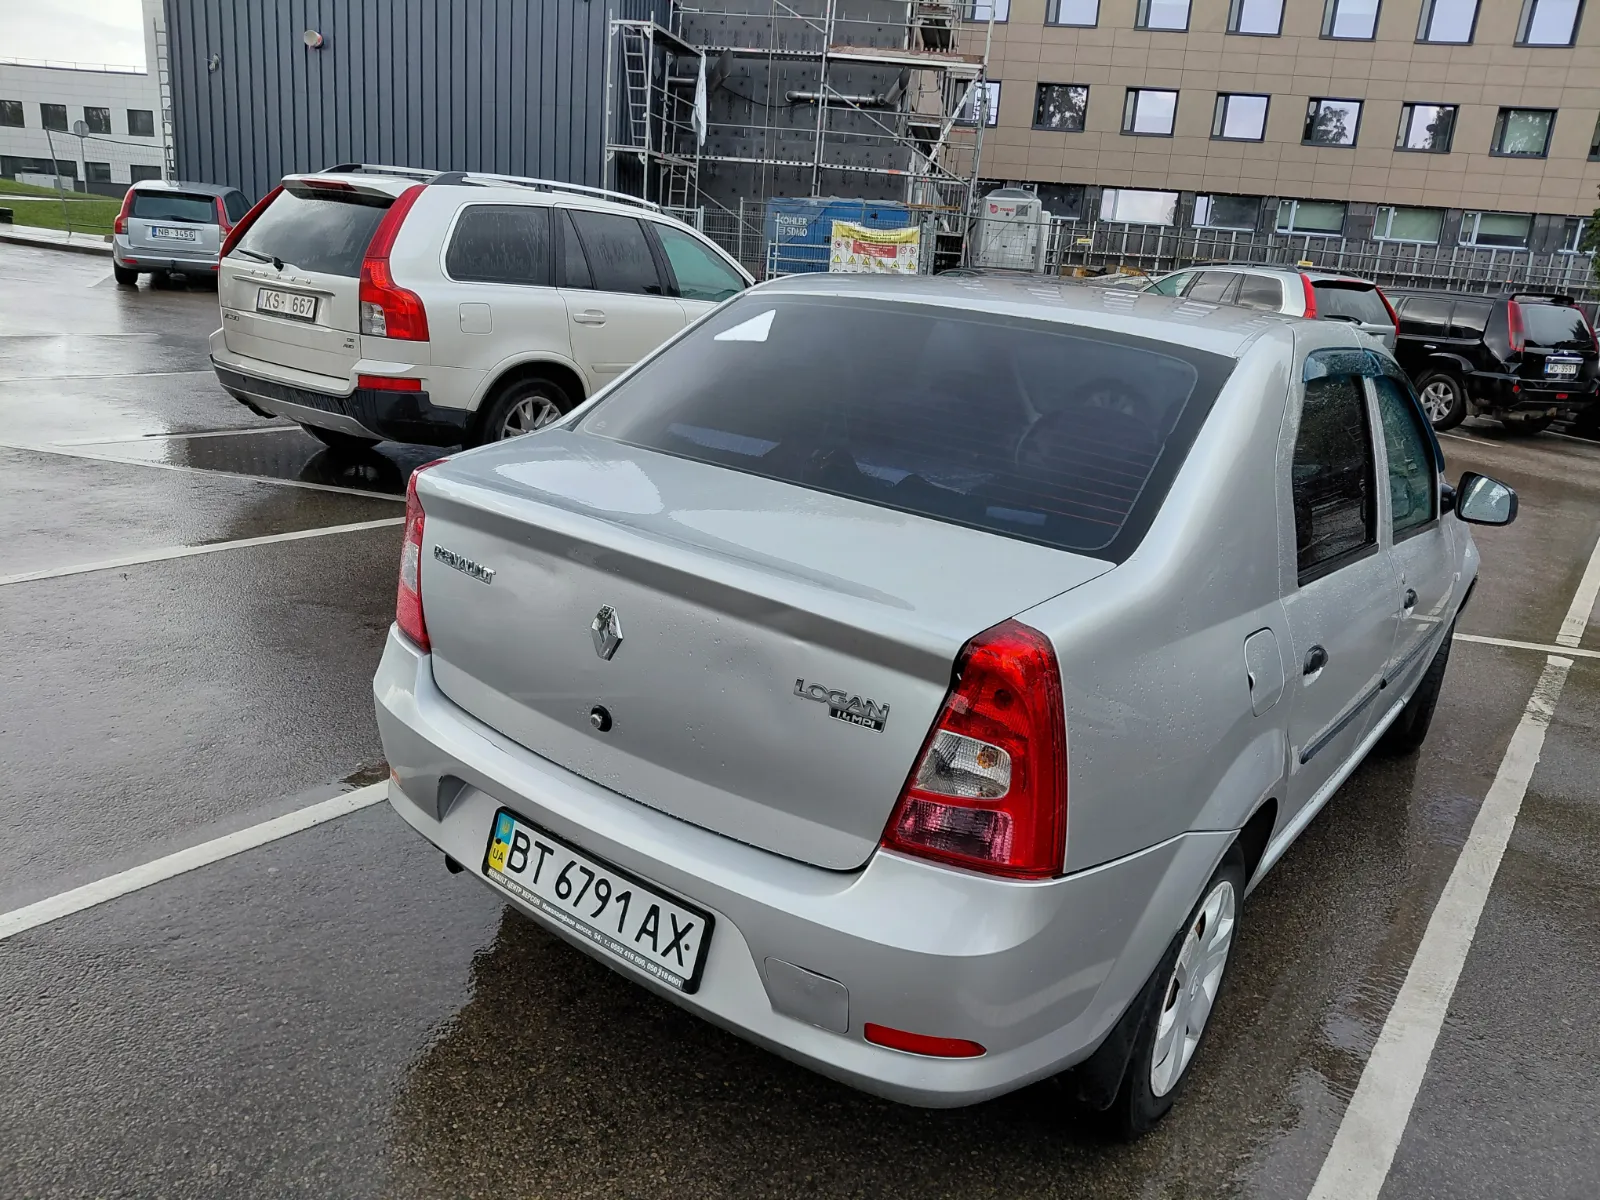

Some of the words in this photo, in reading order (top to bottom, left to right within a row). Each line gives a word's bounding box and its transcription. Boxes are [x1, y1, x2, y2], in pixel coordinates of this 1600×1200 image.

[786, 227, 808, 237] SDMO
[434, 544, 496, 585] RENAULT
[793, 677, 890, 721] LOGAN
[836, 710, 851, 721] 1.4
[851, 714, 876, 729] MPI
[492, 847, 504, 864] UA
[487, 868, 507, 885] RENAULT
[506, 829, 555, 885] BT
[554, 860, 632, 934] 6791
[634, 903, 695, 967] AX
